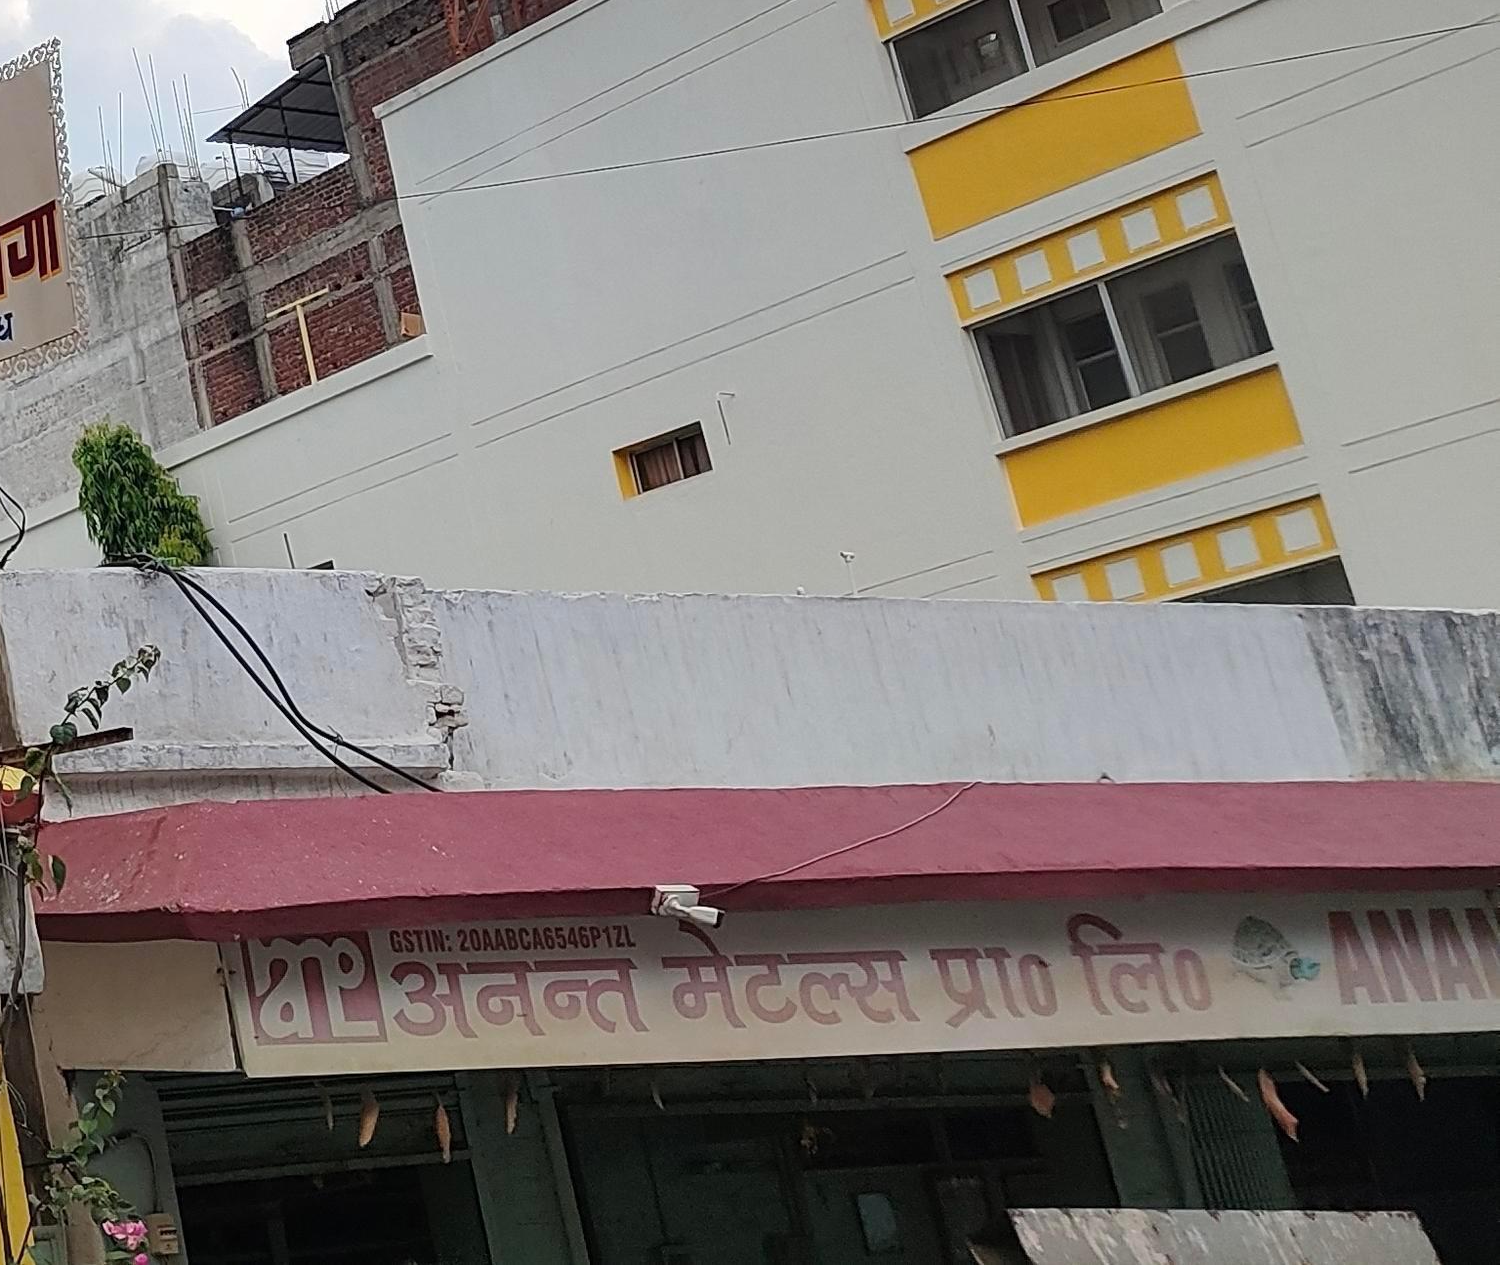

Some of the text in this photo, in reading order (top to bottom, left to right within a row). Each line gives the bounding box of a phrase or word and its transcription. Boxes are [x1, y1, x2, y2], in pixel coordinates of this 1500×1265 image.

[389, 928, 452, 954] GSTIN:
[390, 958, 650, 1039] अनन्त
[664, 920, 920, 1030] मेटल्स
